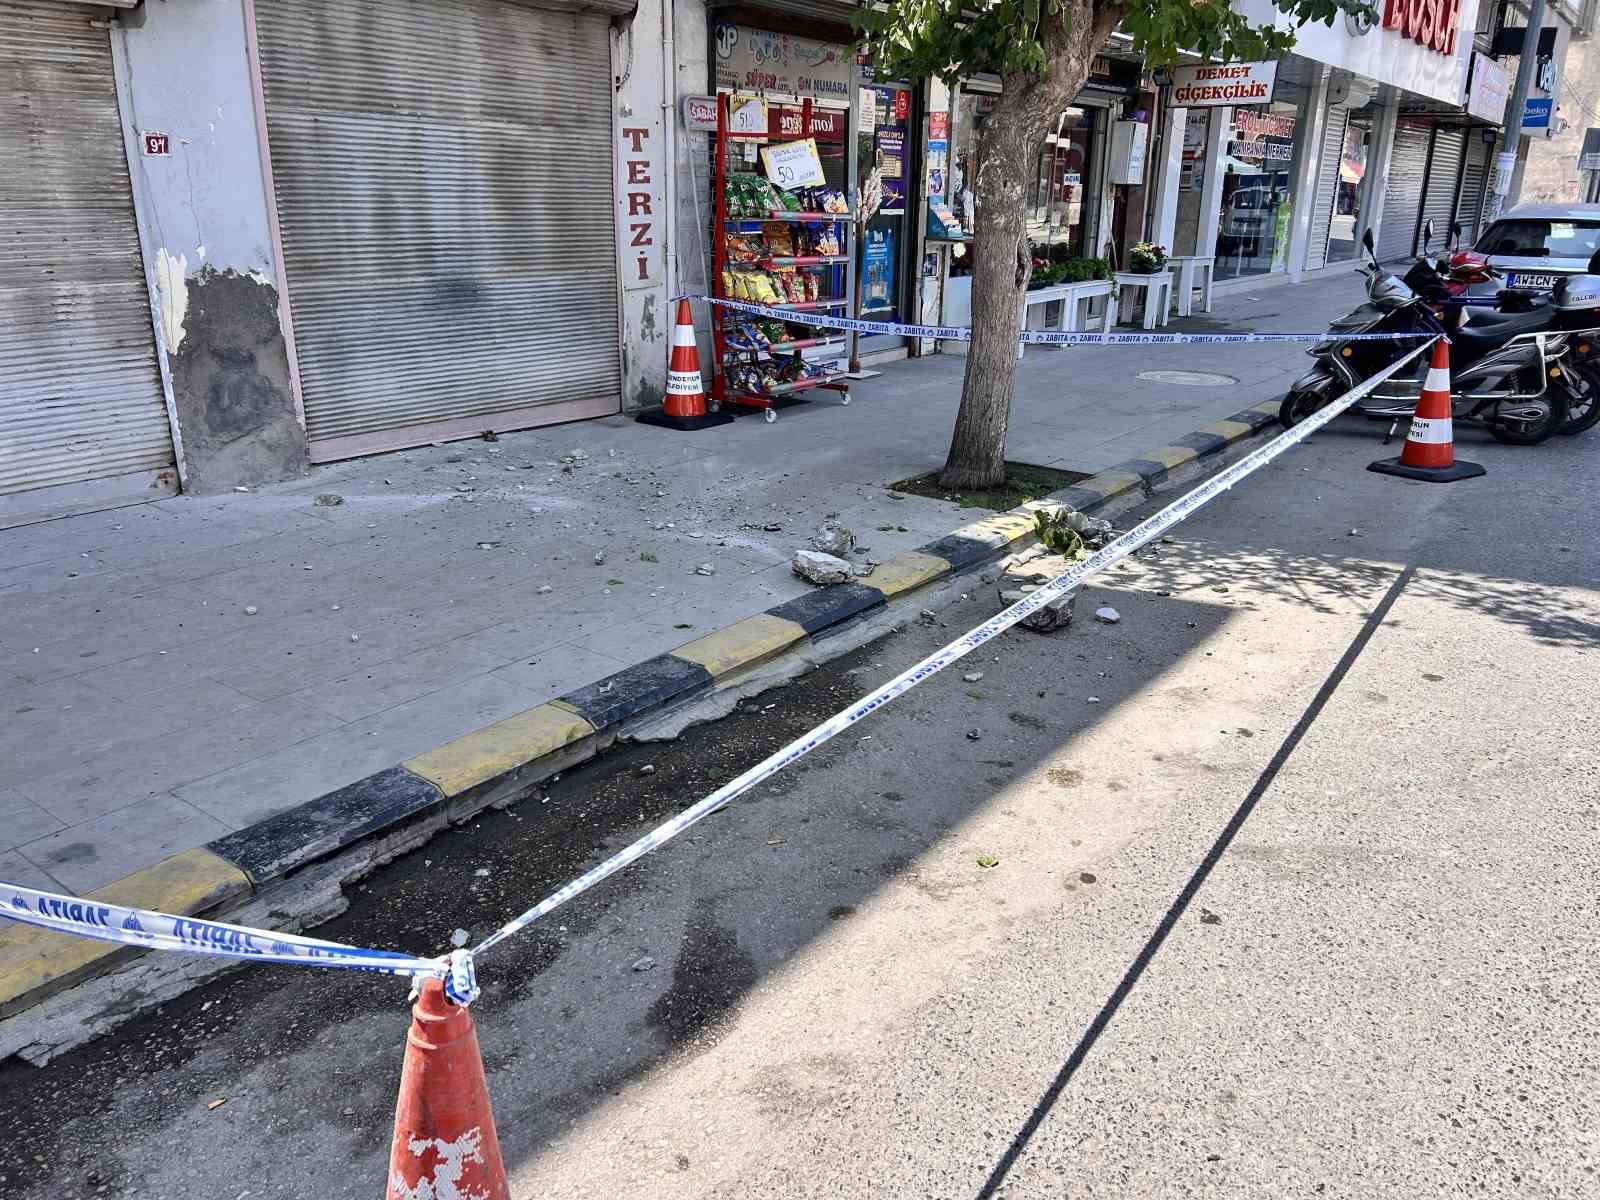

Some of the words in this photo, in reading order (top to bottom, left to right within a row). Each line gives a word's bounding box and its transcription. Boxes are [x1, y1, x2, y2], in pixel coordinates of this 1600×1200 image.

[1196, 67, 1251, 80] DEMET
[814, 79, 848, 95] NUMARA
[1175, 80, 1268, 102] ÇİÇEKÇİLİK
[622, 128, 653, 280] TERZİ
